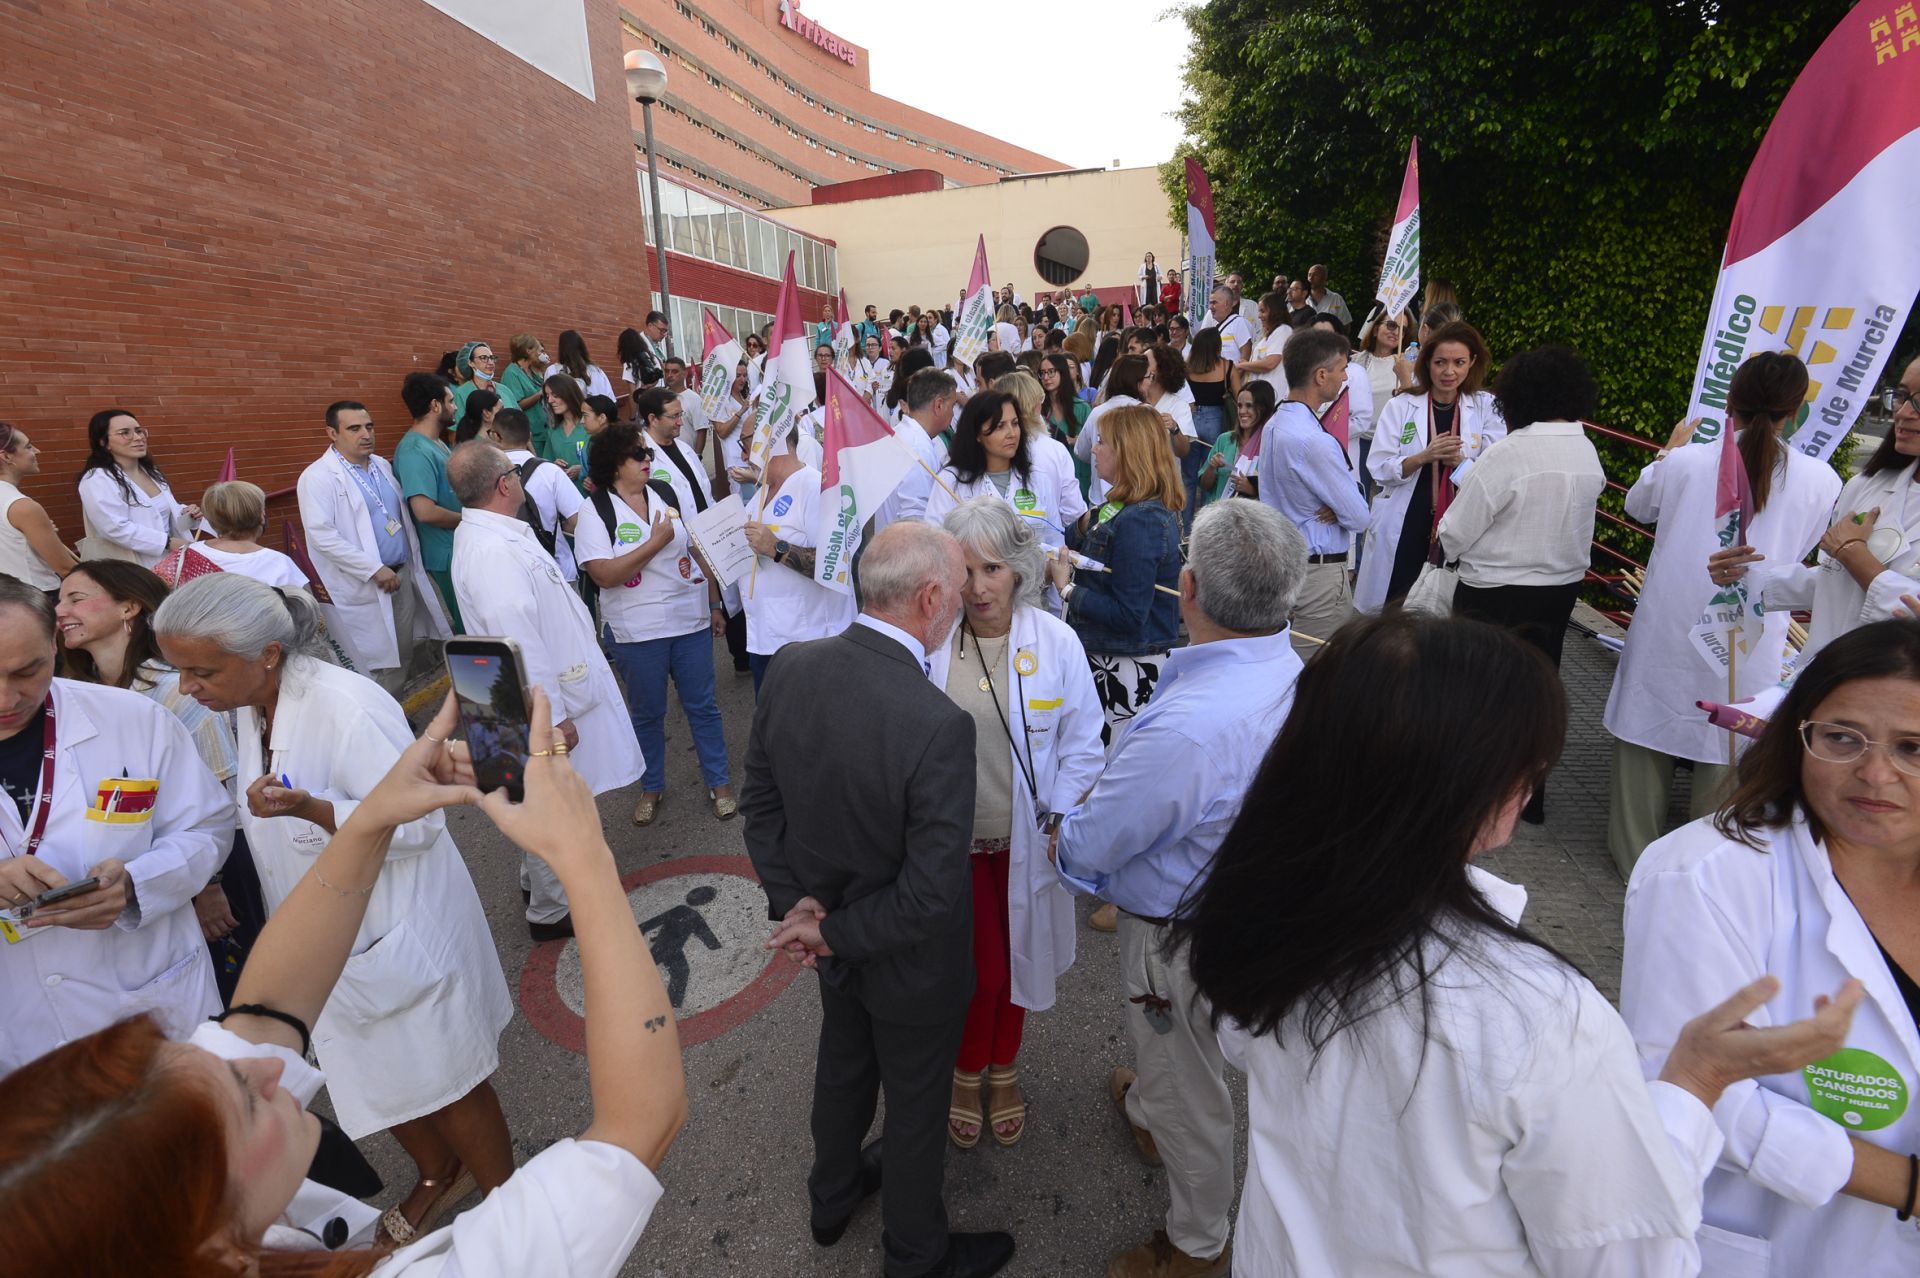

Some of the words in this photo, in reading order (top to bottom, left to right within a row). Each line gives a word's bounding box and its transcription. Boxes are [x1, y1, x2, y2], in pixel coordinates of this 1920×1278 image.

[779, 0, 857, 67] Arrixaca
[1699, 294, 1757, 410] Médico
[1820, 395, 1850, 427] de
[1836, 304, 1897, 393] Murcia
[1811, 1077, 1898, 1101] CANSADOS
[1825, 1092, 1847, 1103] OCT
[1849, 1098, 1890, 1111] HUELGA
